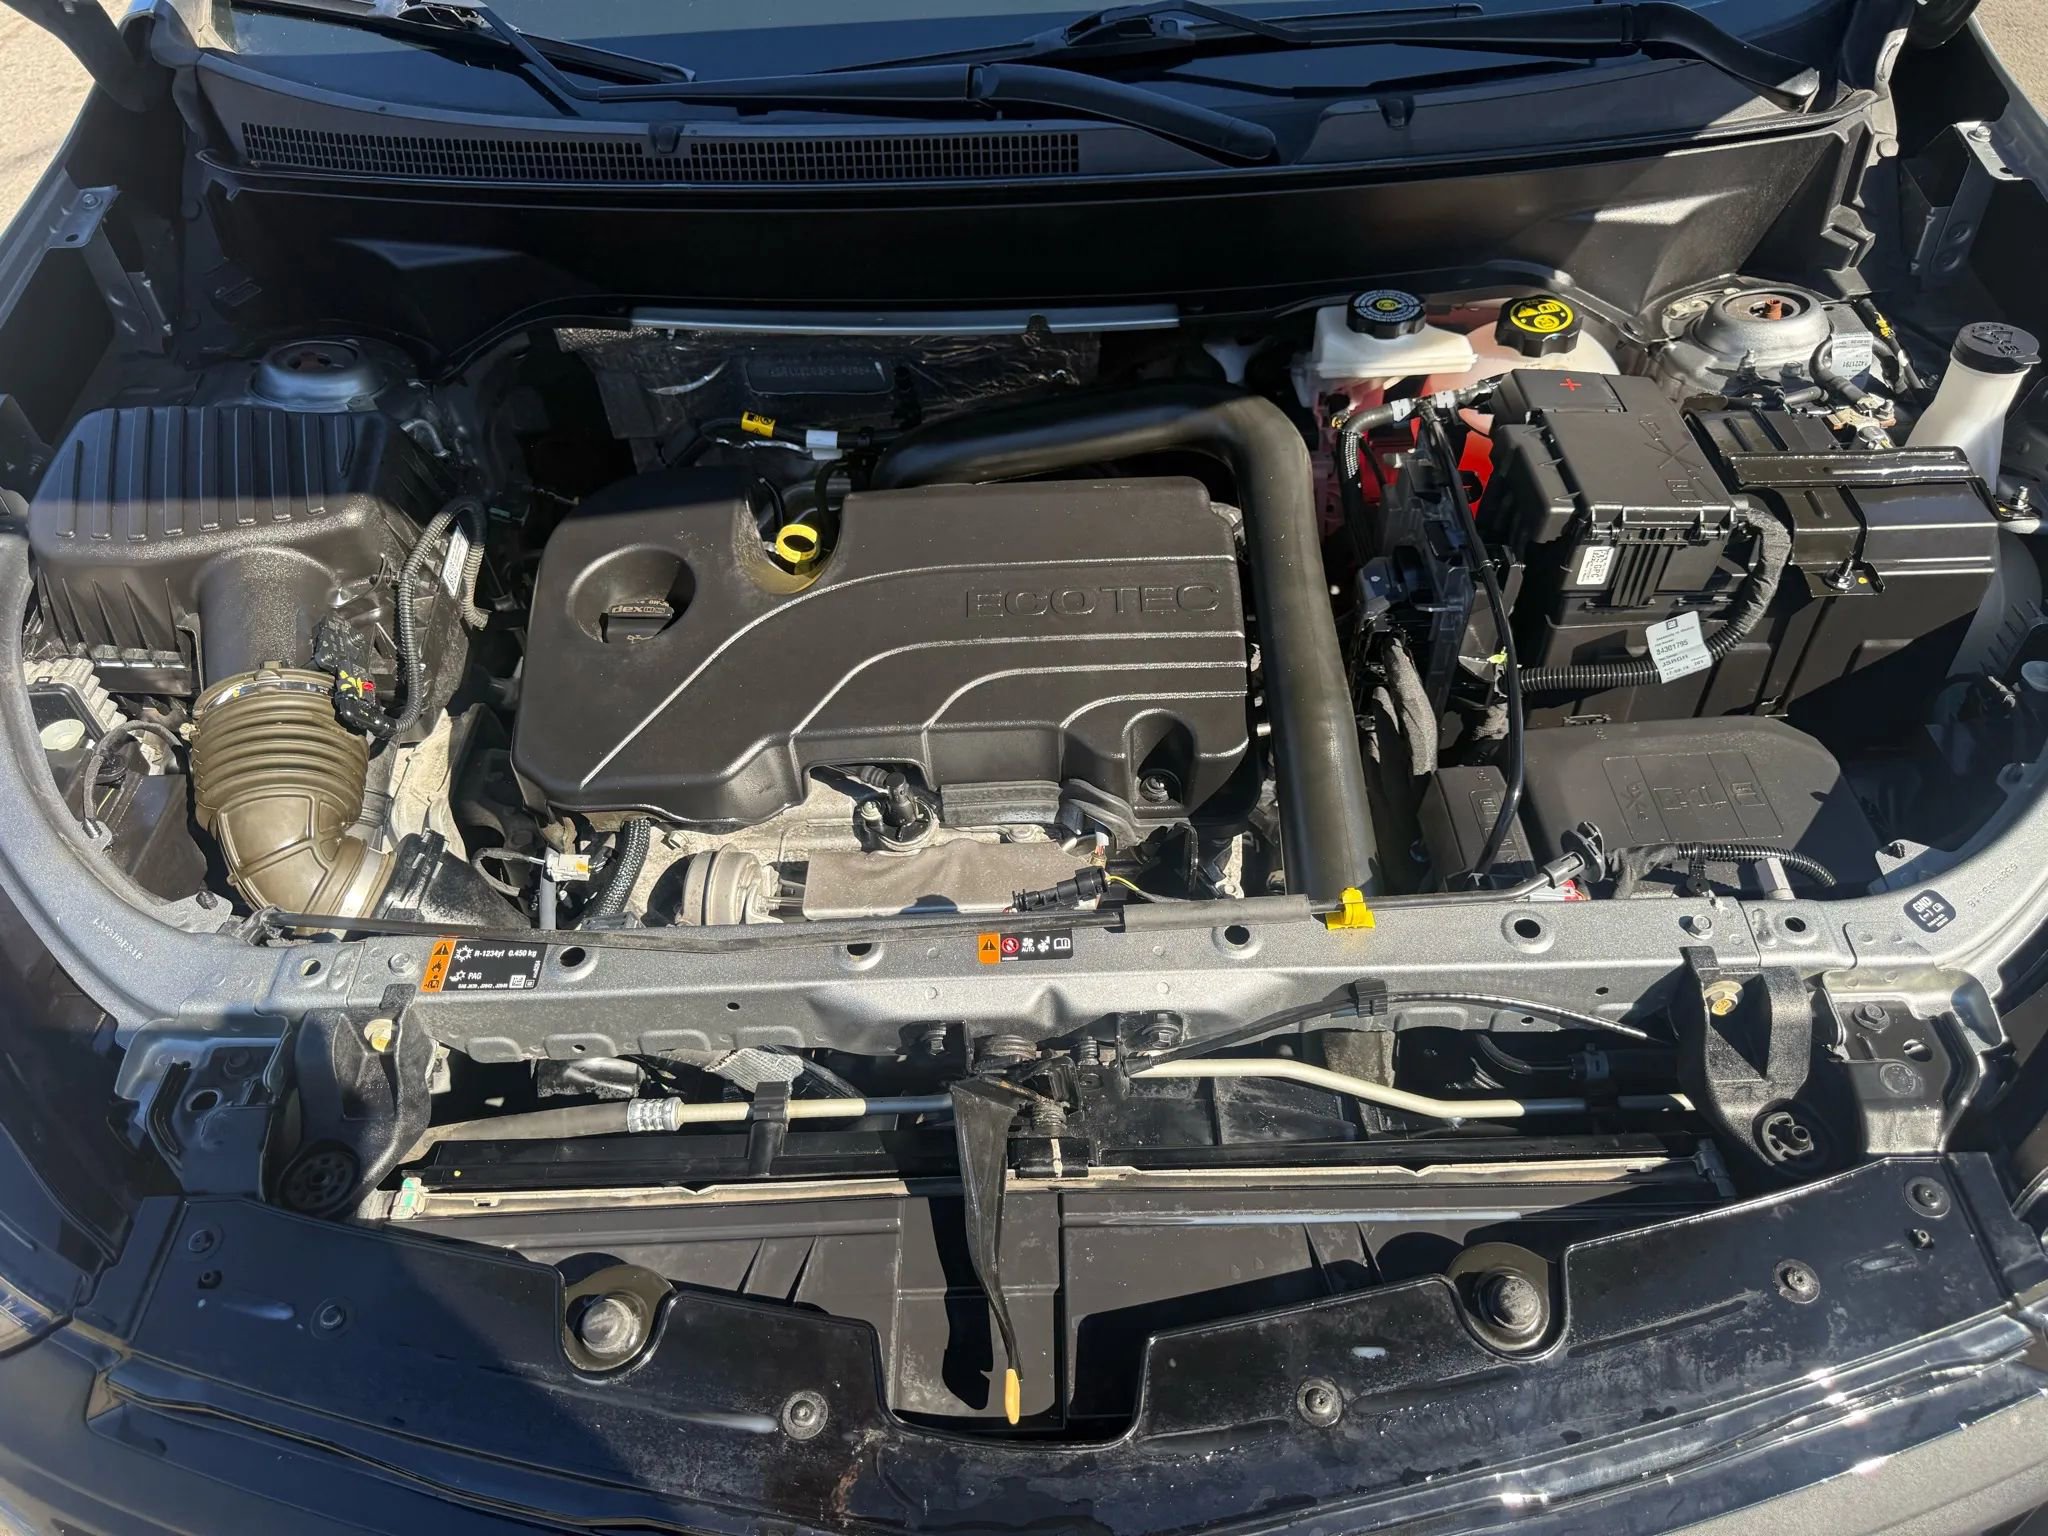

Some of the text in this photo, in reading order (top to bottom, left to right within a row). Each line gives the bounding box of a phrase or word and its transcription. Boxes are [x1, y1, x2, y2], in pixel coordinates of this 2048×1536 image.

[965, 582, 1221, 618] ECOTEC
[611, 605, 666, 613] dexos
[1656, 640, 1688, 656] 84301795
[1912, 896, 1932, 913] GND
[474, 949, 538, 959] R-1234yf 0.450 kg
[467, 972, 482, 980] PAG
